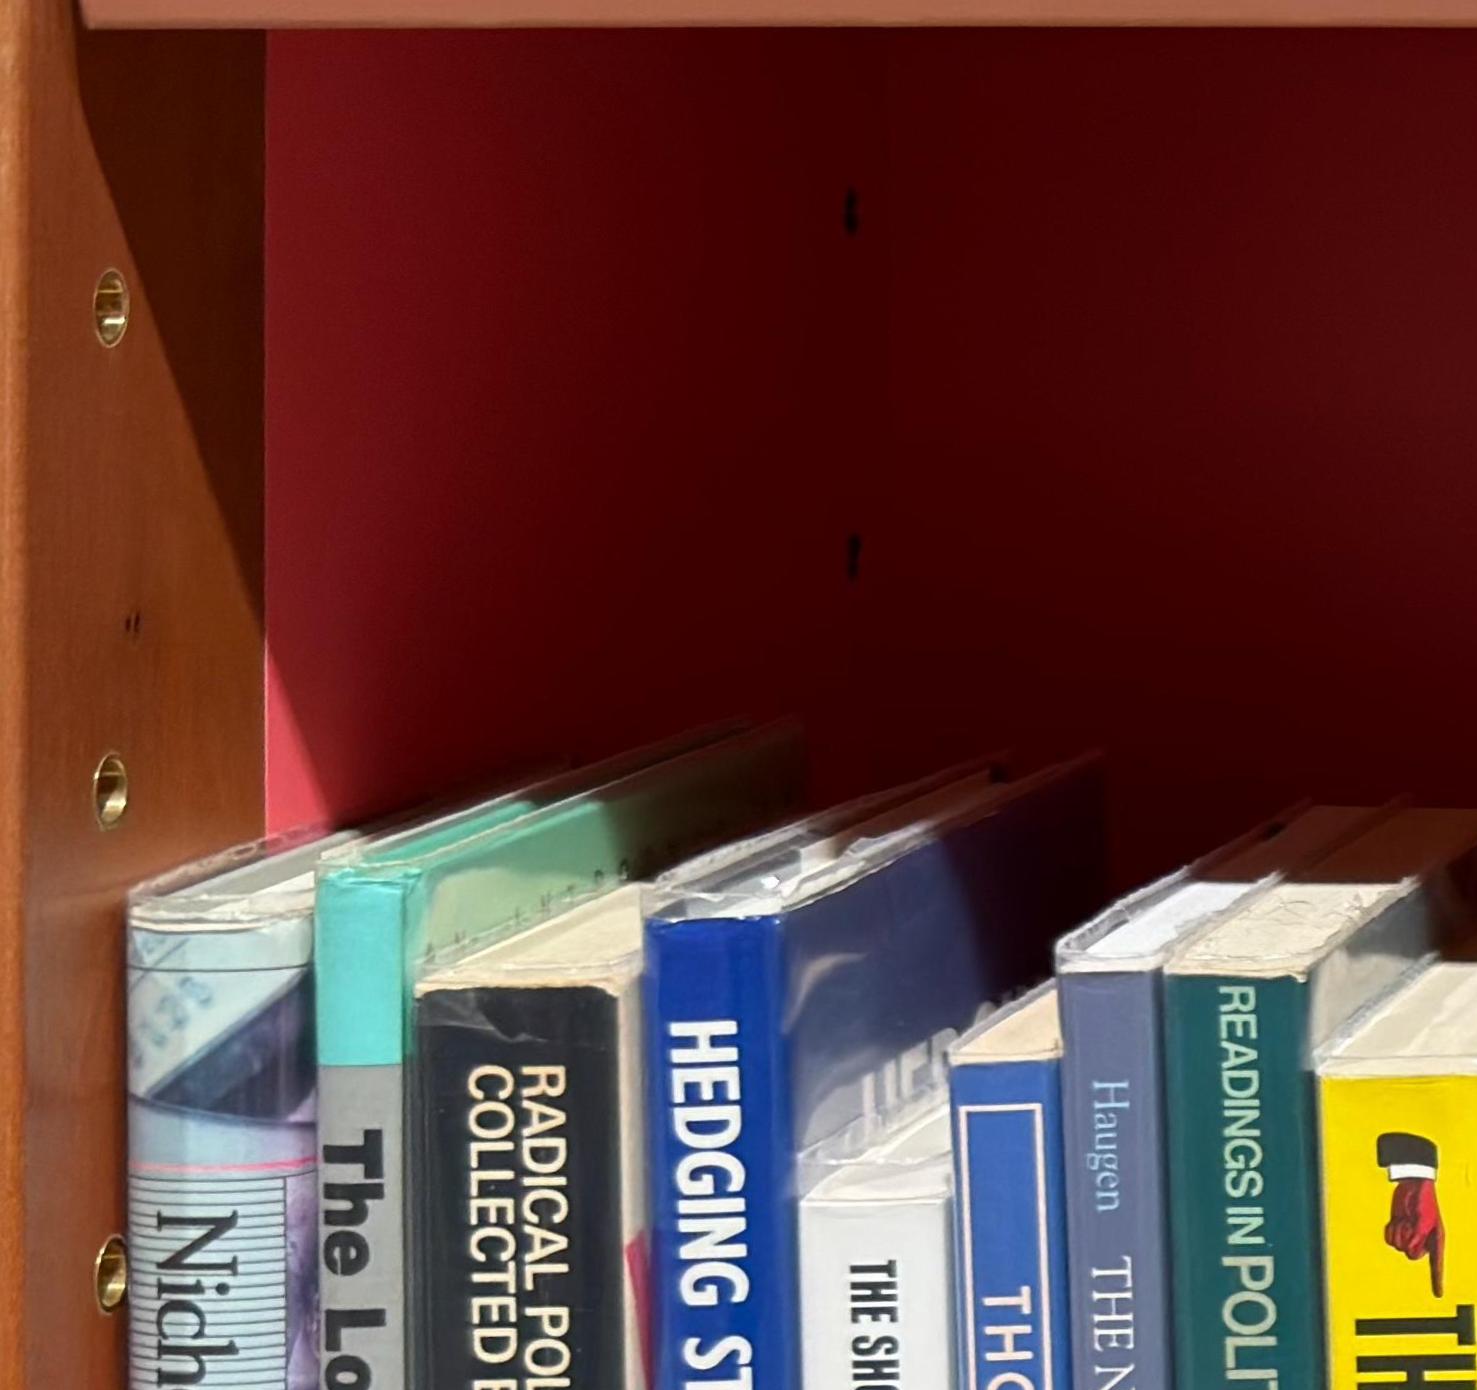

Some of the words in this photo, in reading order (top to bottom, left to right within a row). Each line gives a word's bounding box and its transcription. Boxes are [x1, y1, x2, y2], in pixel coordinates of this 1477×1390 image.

[323, 1130, 381, 1275] The
[520, 1065, 569, 1289] RADICAL
[668, 1020, 751, 1306] HEDGING
[1085, 1080, 1129, 1212] Haugen
[1091, 1255, 1133, 1353] THE
